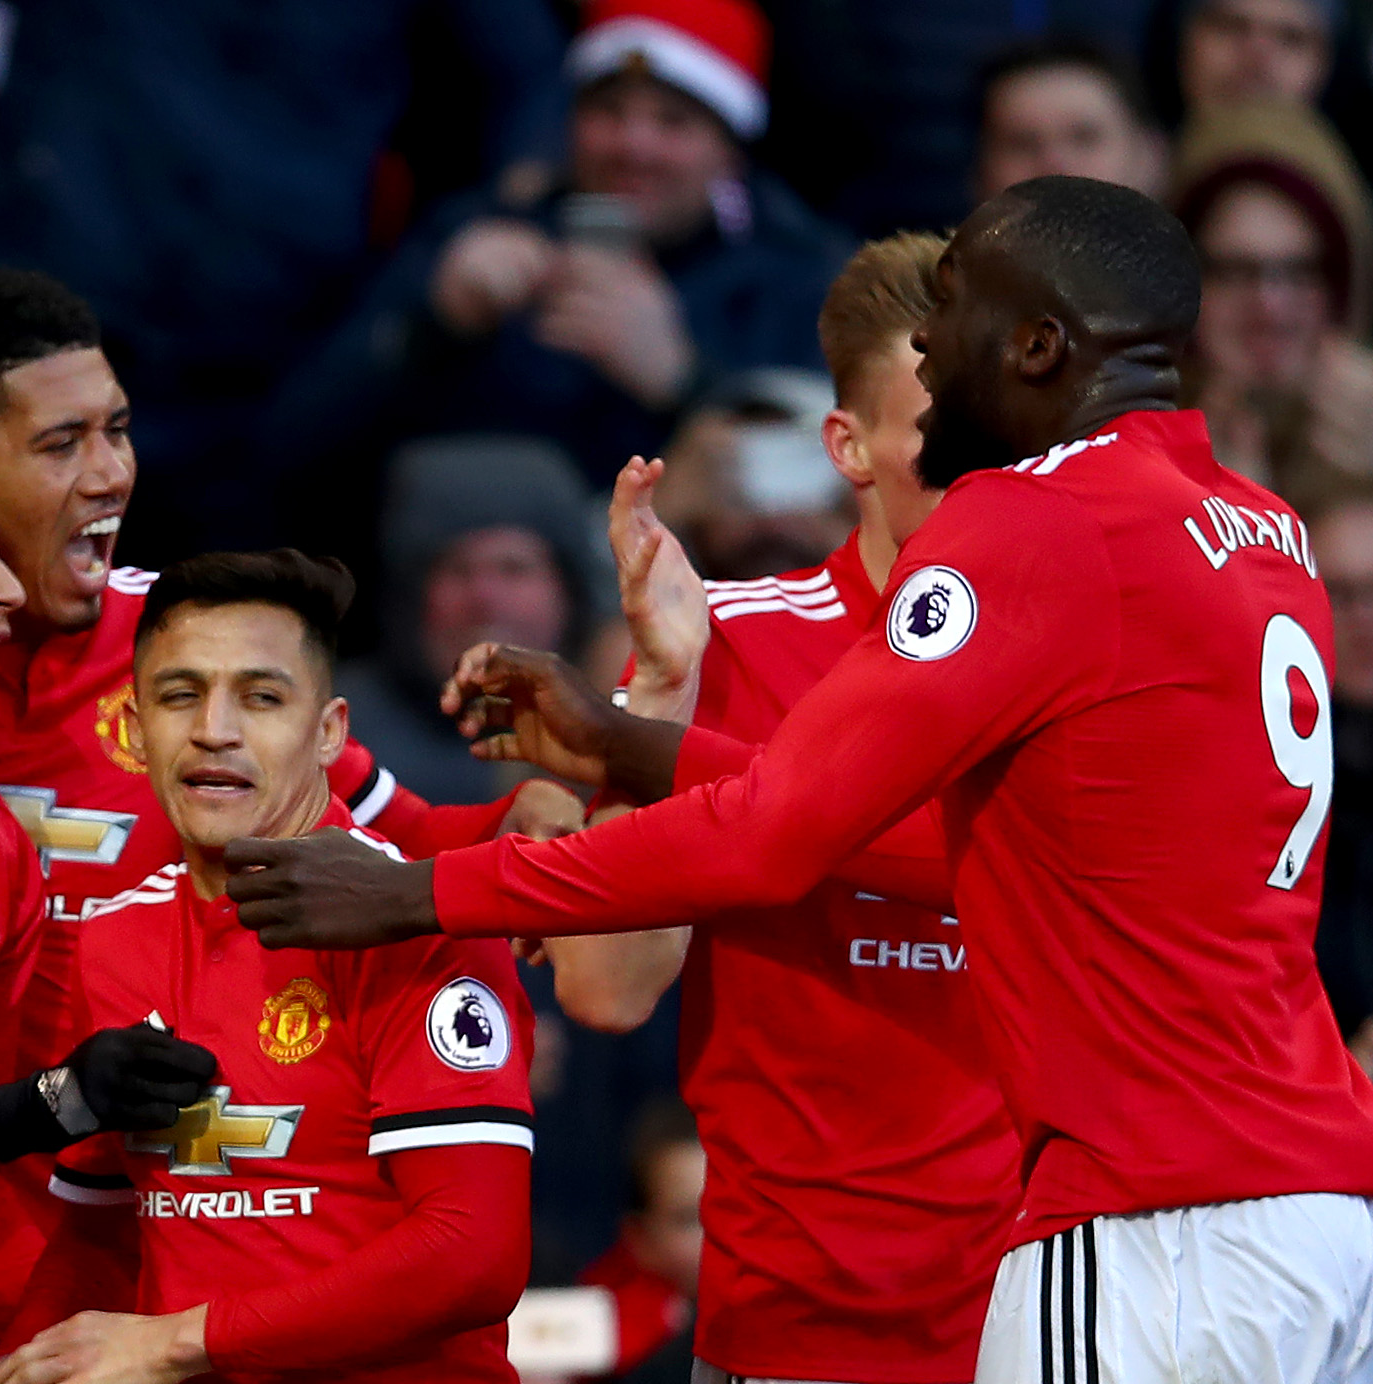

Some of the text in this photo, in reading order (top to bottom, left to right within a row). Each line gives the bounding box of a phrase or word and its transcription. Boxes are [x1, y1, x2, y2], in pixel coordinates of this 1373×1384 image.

[1183, 496, 1318, 580] LUKAKU
[1259, 613, 1333, 890] 9
[848, 937, 968, 972] CHEV
